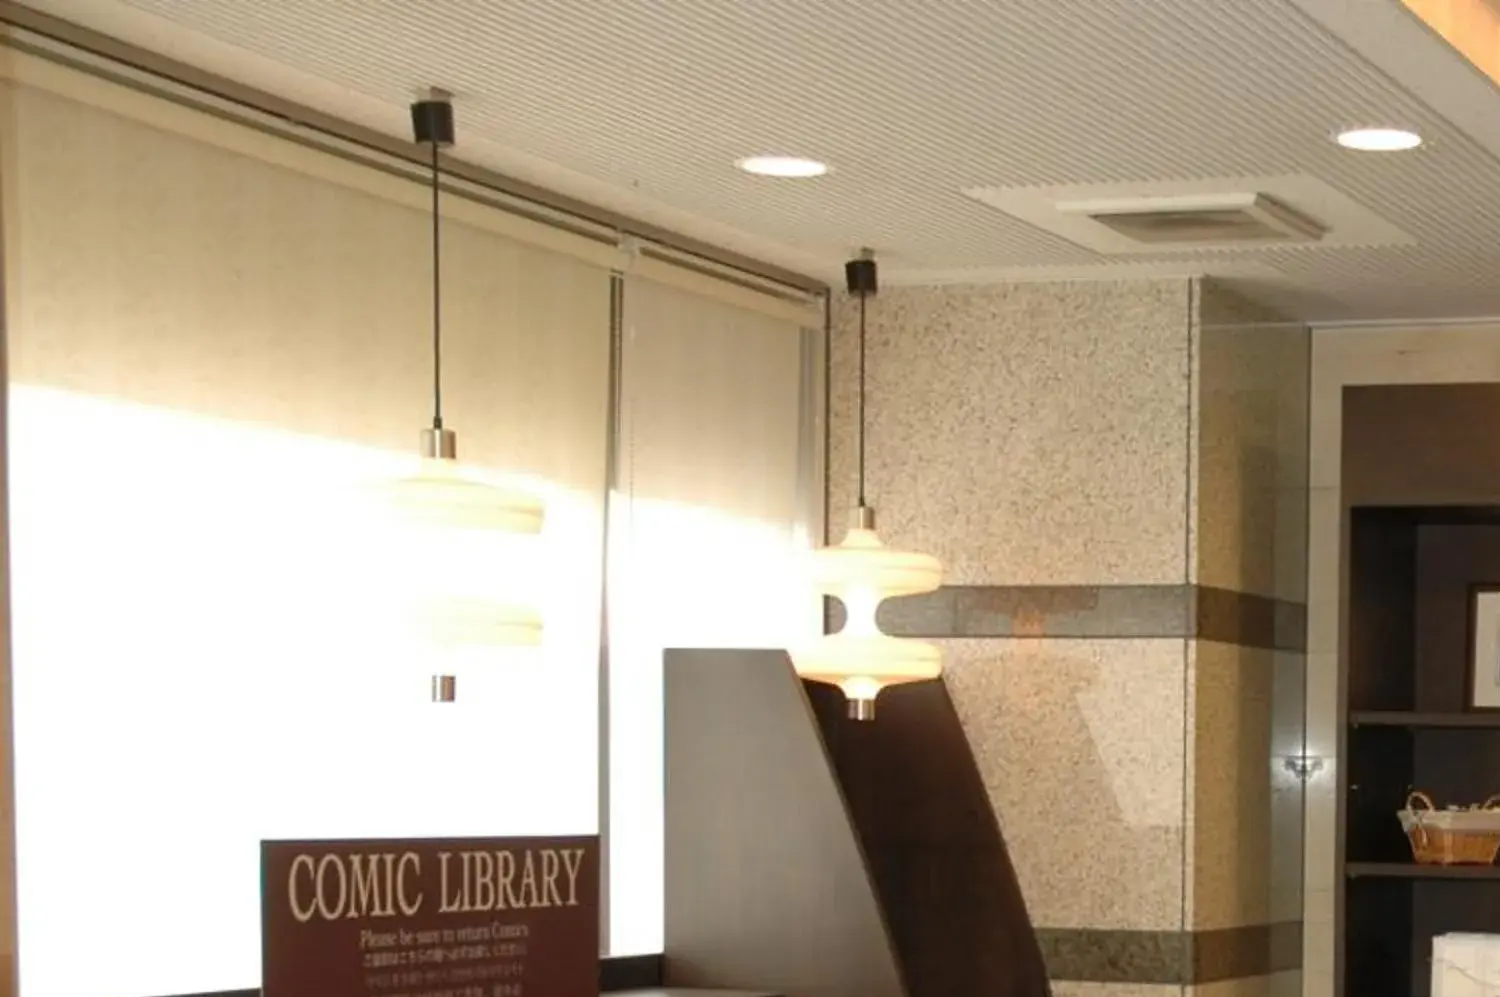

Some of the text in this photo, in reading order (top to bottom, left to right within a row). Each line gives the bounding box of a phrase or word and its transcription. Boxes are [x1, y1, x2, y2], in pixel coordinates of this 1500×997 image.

[288, 849, 585, 922] COMIC LIBRARY
[360, 929, 397, 947] Please
[400, 928, 412, 945] be
[443, 929, 454, 942] to
[457, 927, 491, 941] return
